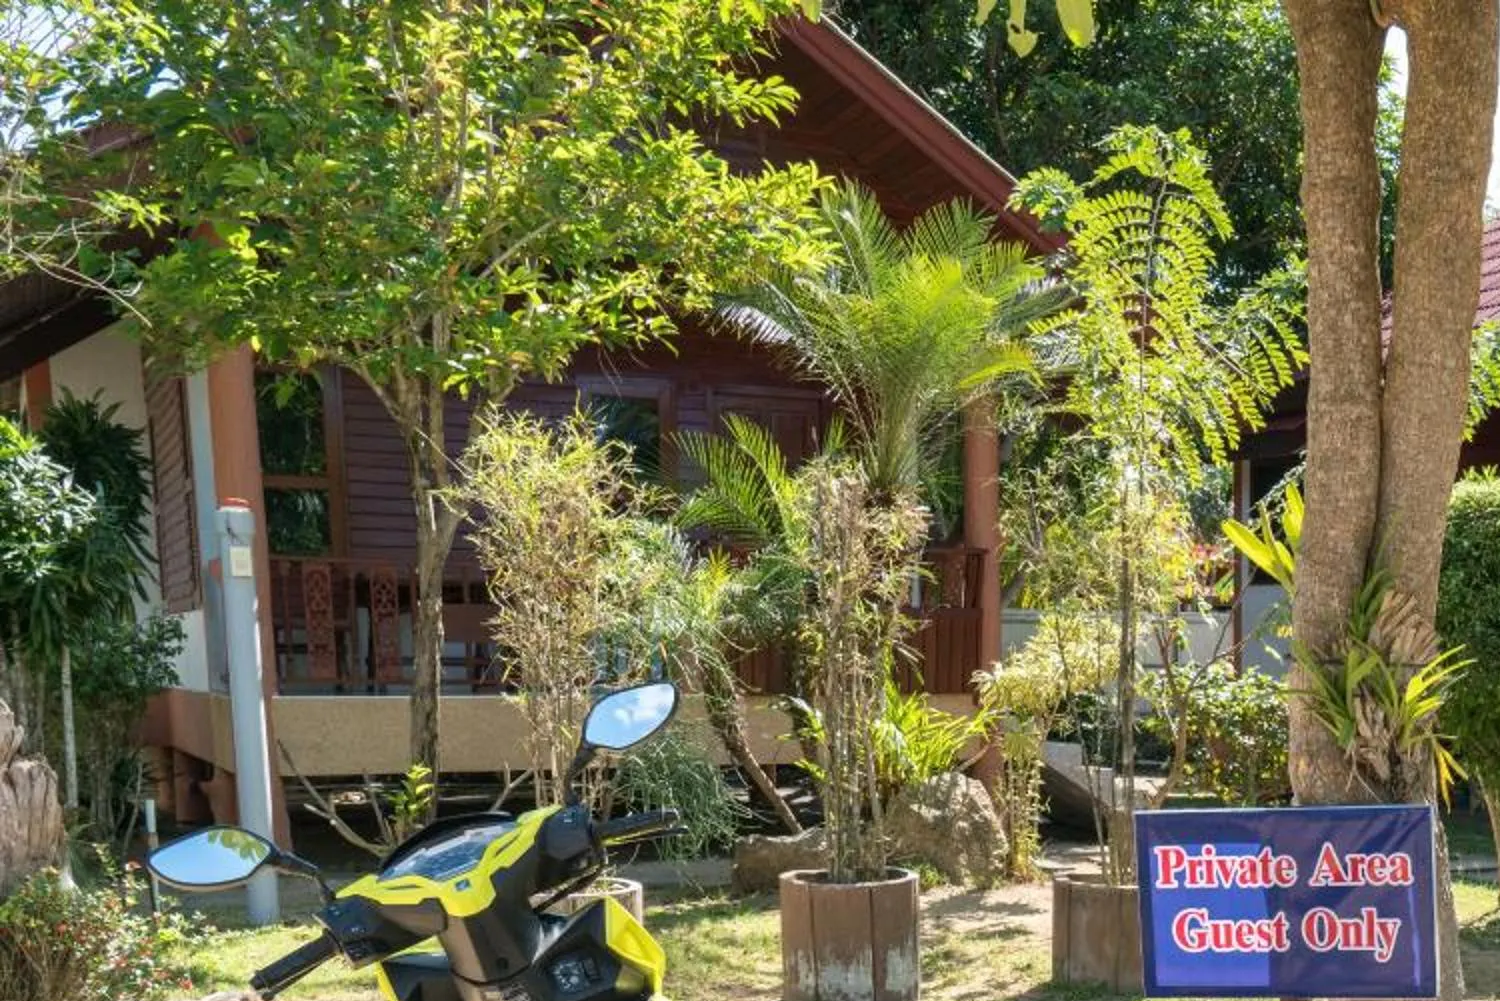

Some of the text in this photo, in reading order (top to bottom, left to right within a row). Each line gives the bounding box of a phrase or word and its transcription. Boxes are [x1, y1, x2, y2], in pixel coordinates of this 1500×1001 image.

[1154, 842, 1414, 889] Private Area
[1172, 906, 1400, 963] Guest Only
